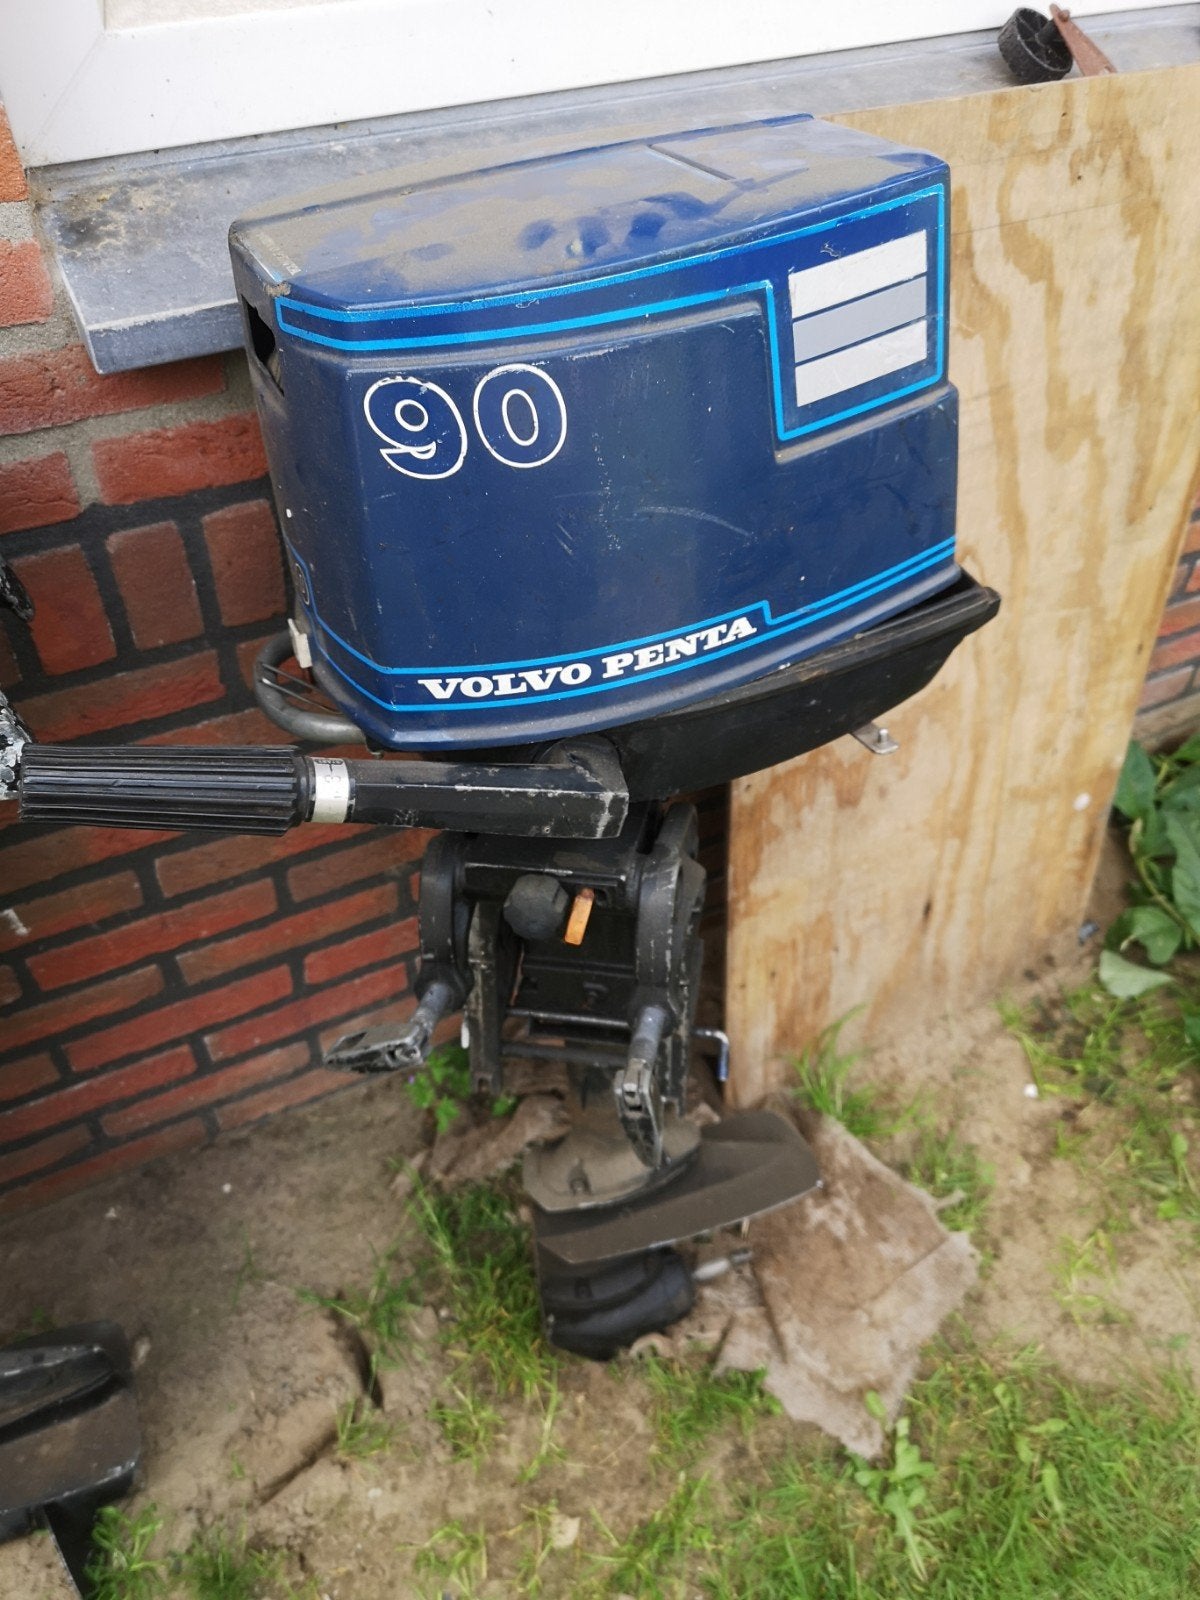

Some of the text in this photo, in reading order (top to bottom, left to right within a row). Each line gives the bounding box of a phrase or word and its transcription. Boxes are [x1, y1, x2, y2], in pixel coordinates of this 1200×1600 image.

[364, 363, 567, 479] 90
[418, 616, 757, 700] VOLVO PENTA
